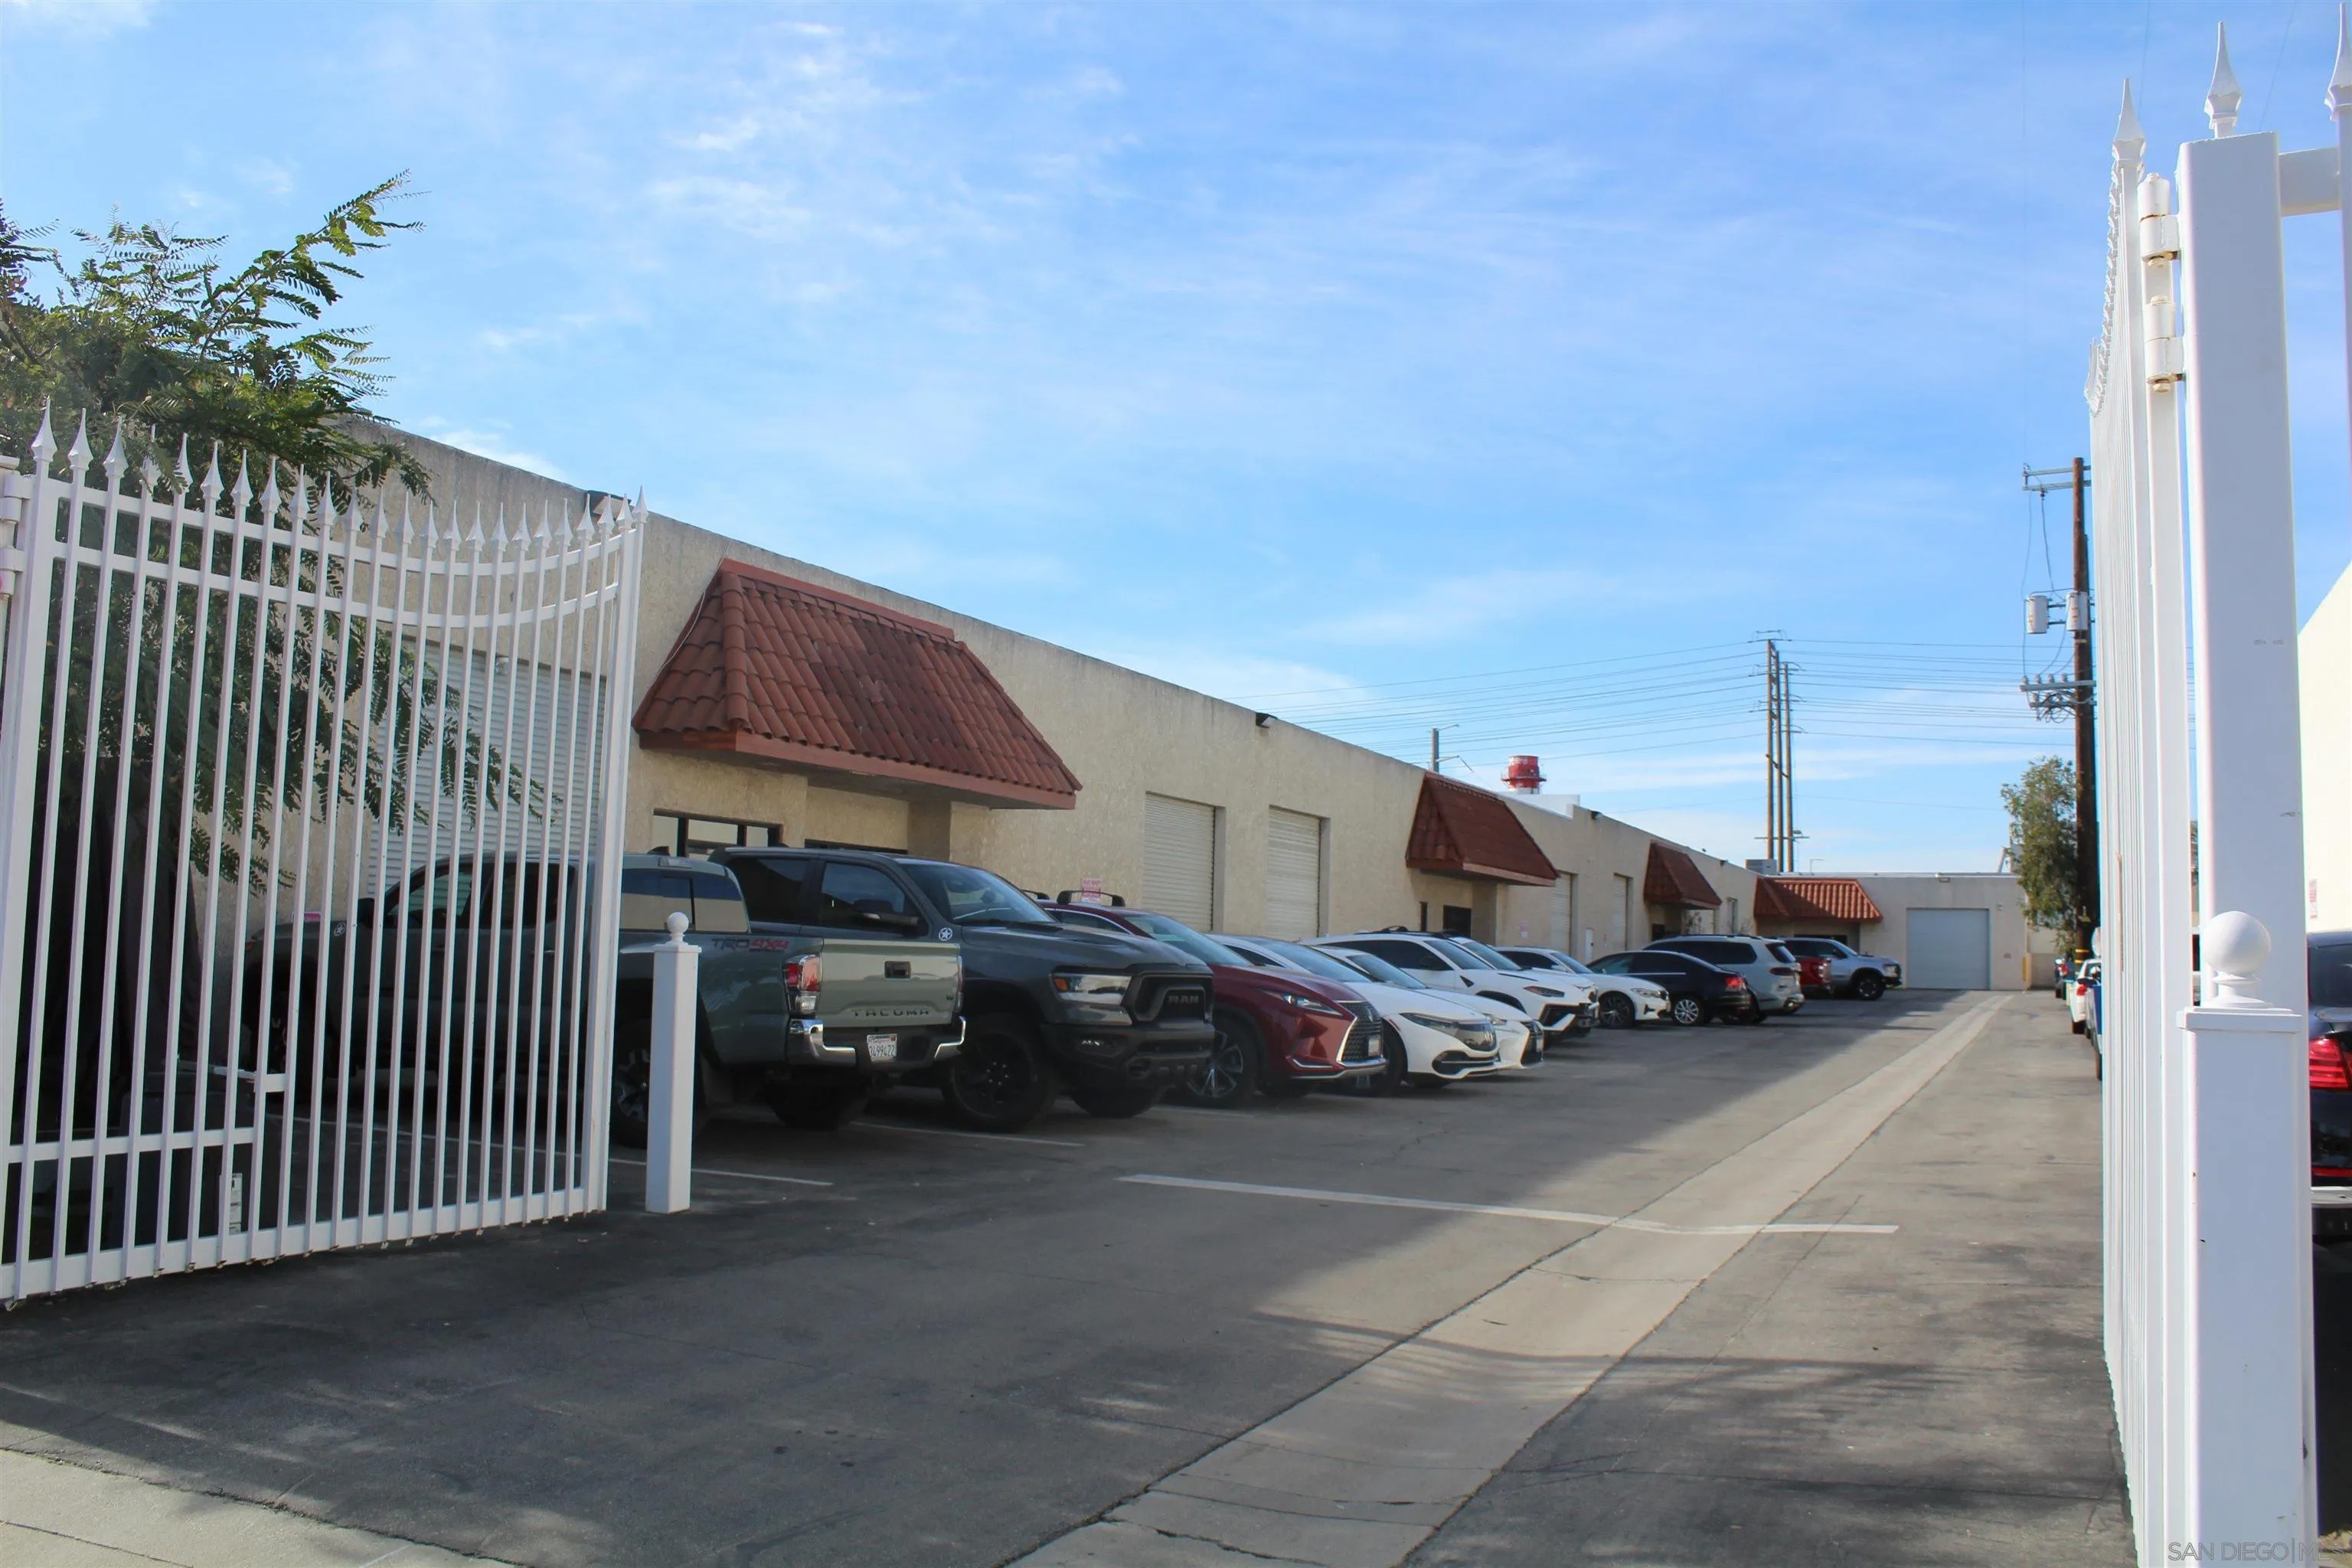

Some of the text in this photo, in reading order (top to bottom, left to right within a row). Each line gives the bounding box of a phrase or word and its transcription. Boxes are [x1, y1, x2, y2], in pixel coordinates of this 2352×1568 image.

[710, 938, 750, 949] TRD
[1168, 995, 1199, 1004] RAM
[851, 1008, 929, 1017] TACOMA
